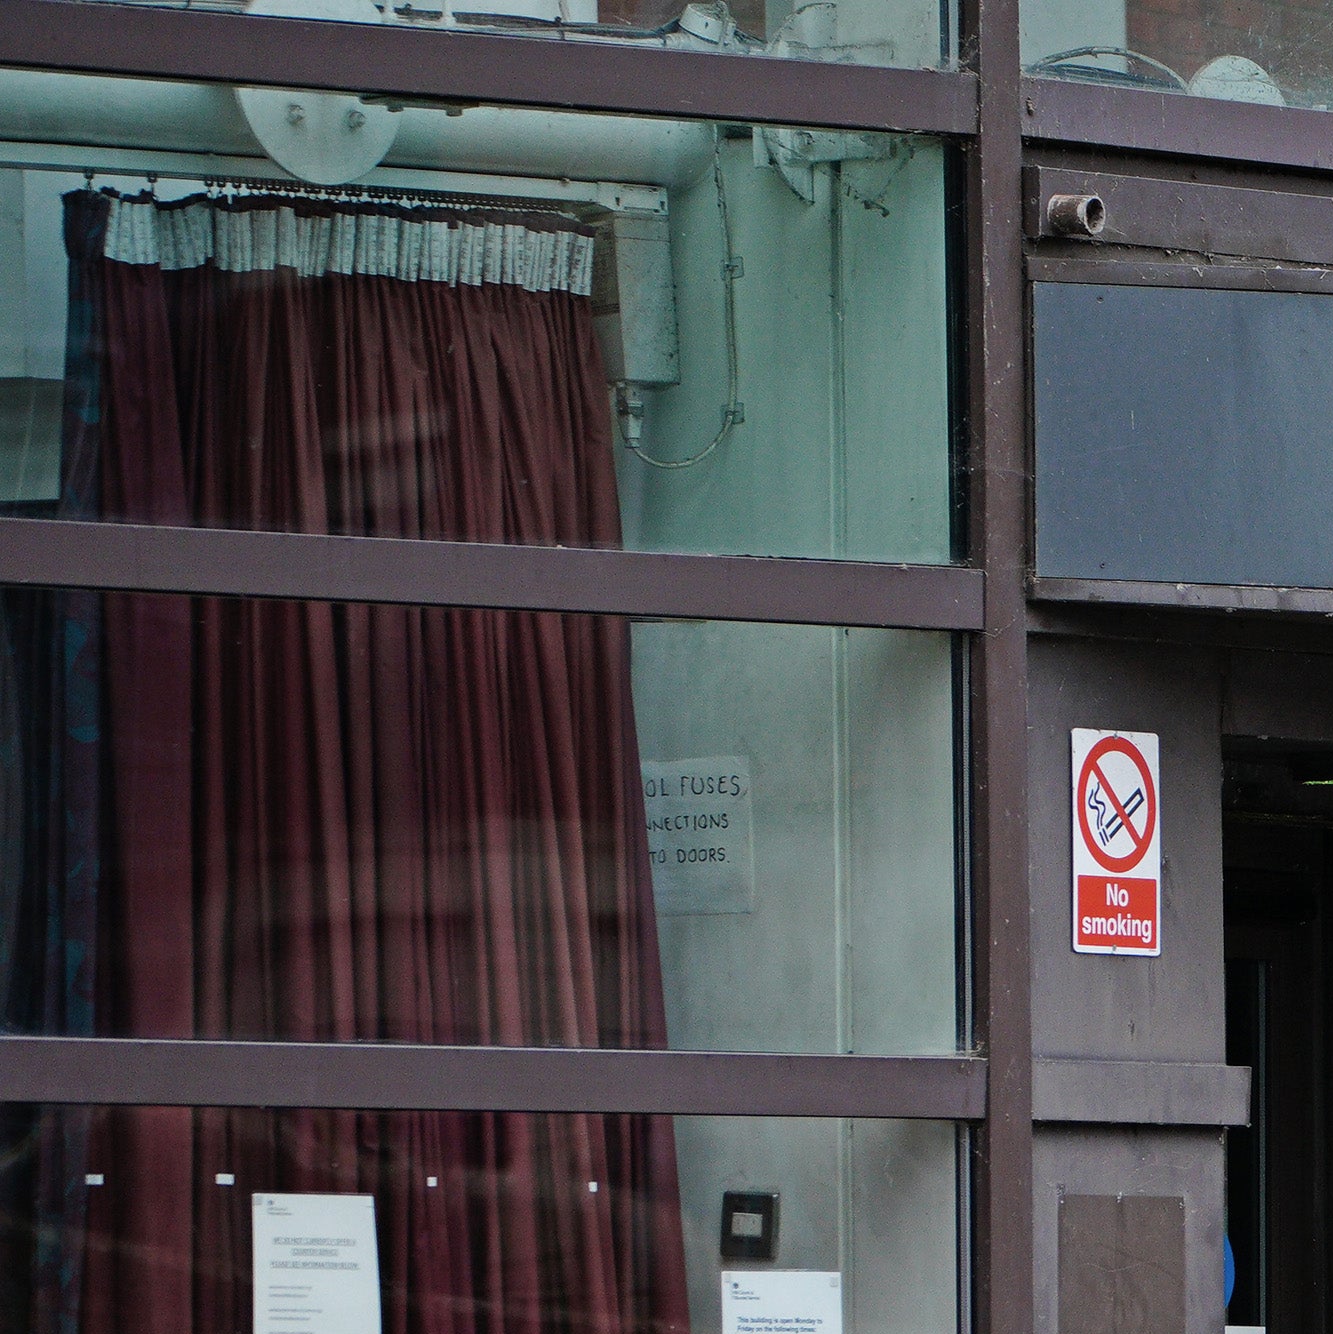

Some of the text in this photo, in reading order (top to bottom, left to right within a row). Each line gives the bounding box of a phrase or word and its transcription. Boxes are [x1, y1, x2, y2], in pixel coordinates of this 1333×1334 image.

[677, 847, 730, 864] DOORS.
[1106, 882, 1129, 908] No
[1082, 912, 1153, 944] smoking
